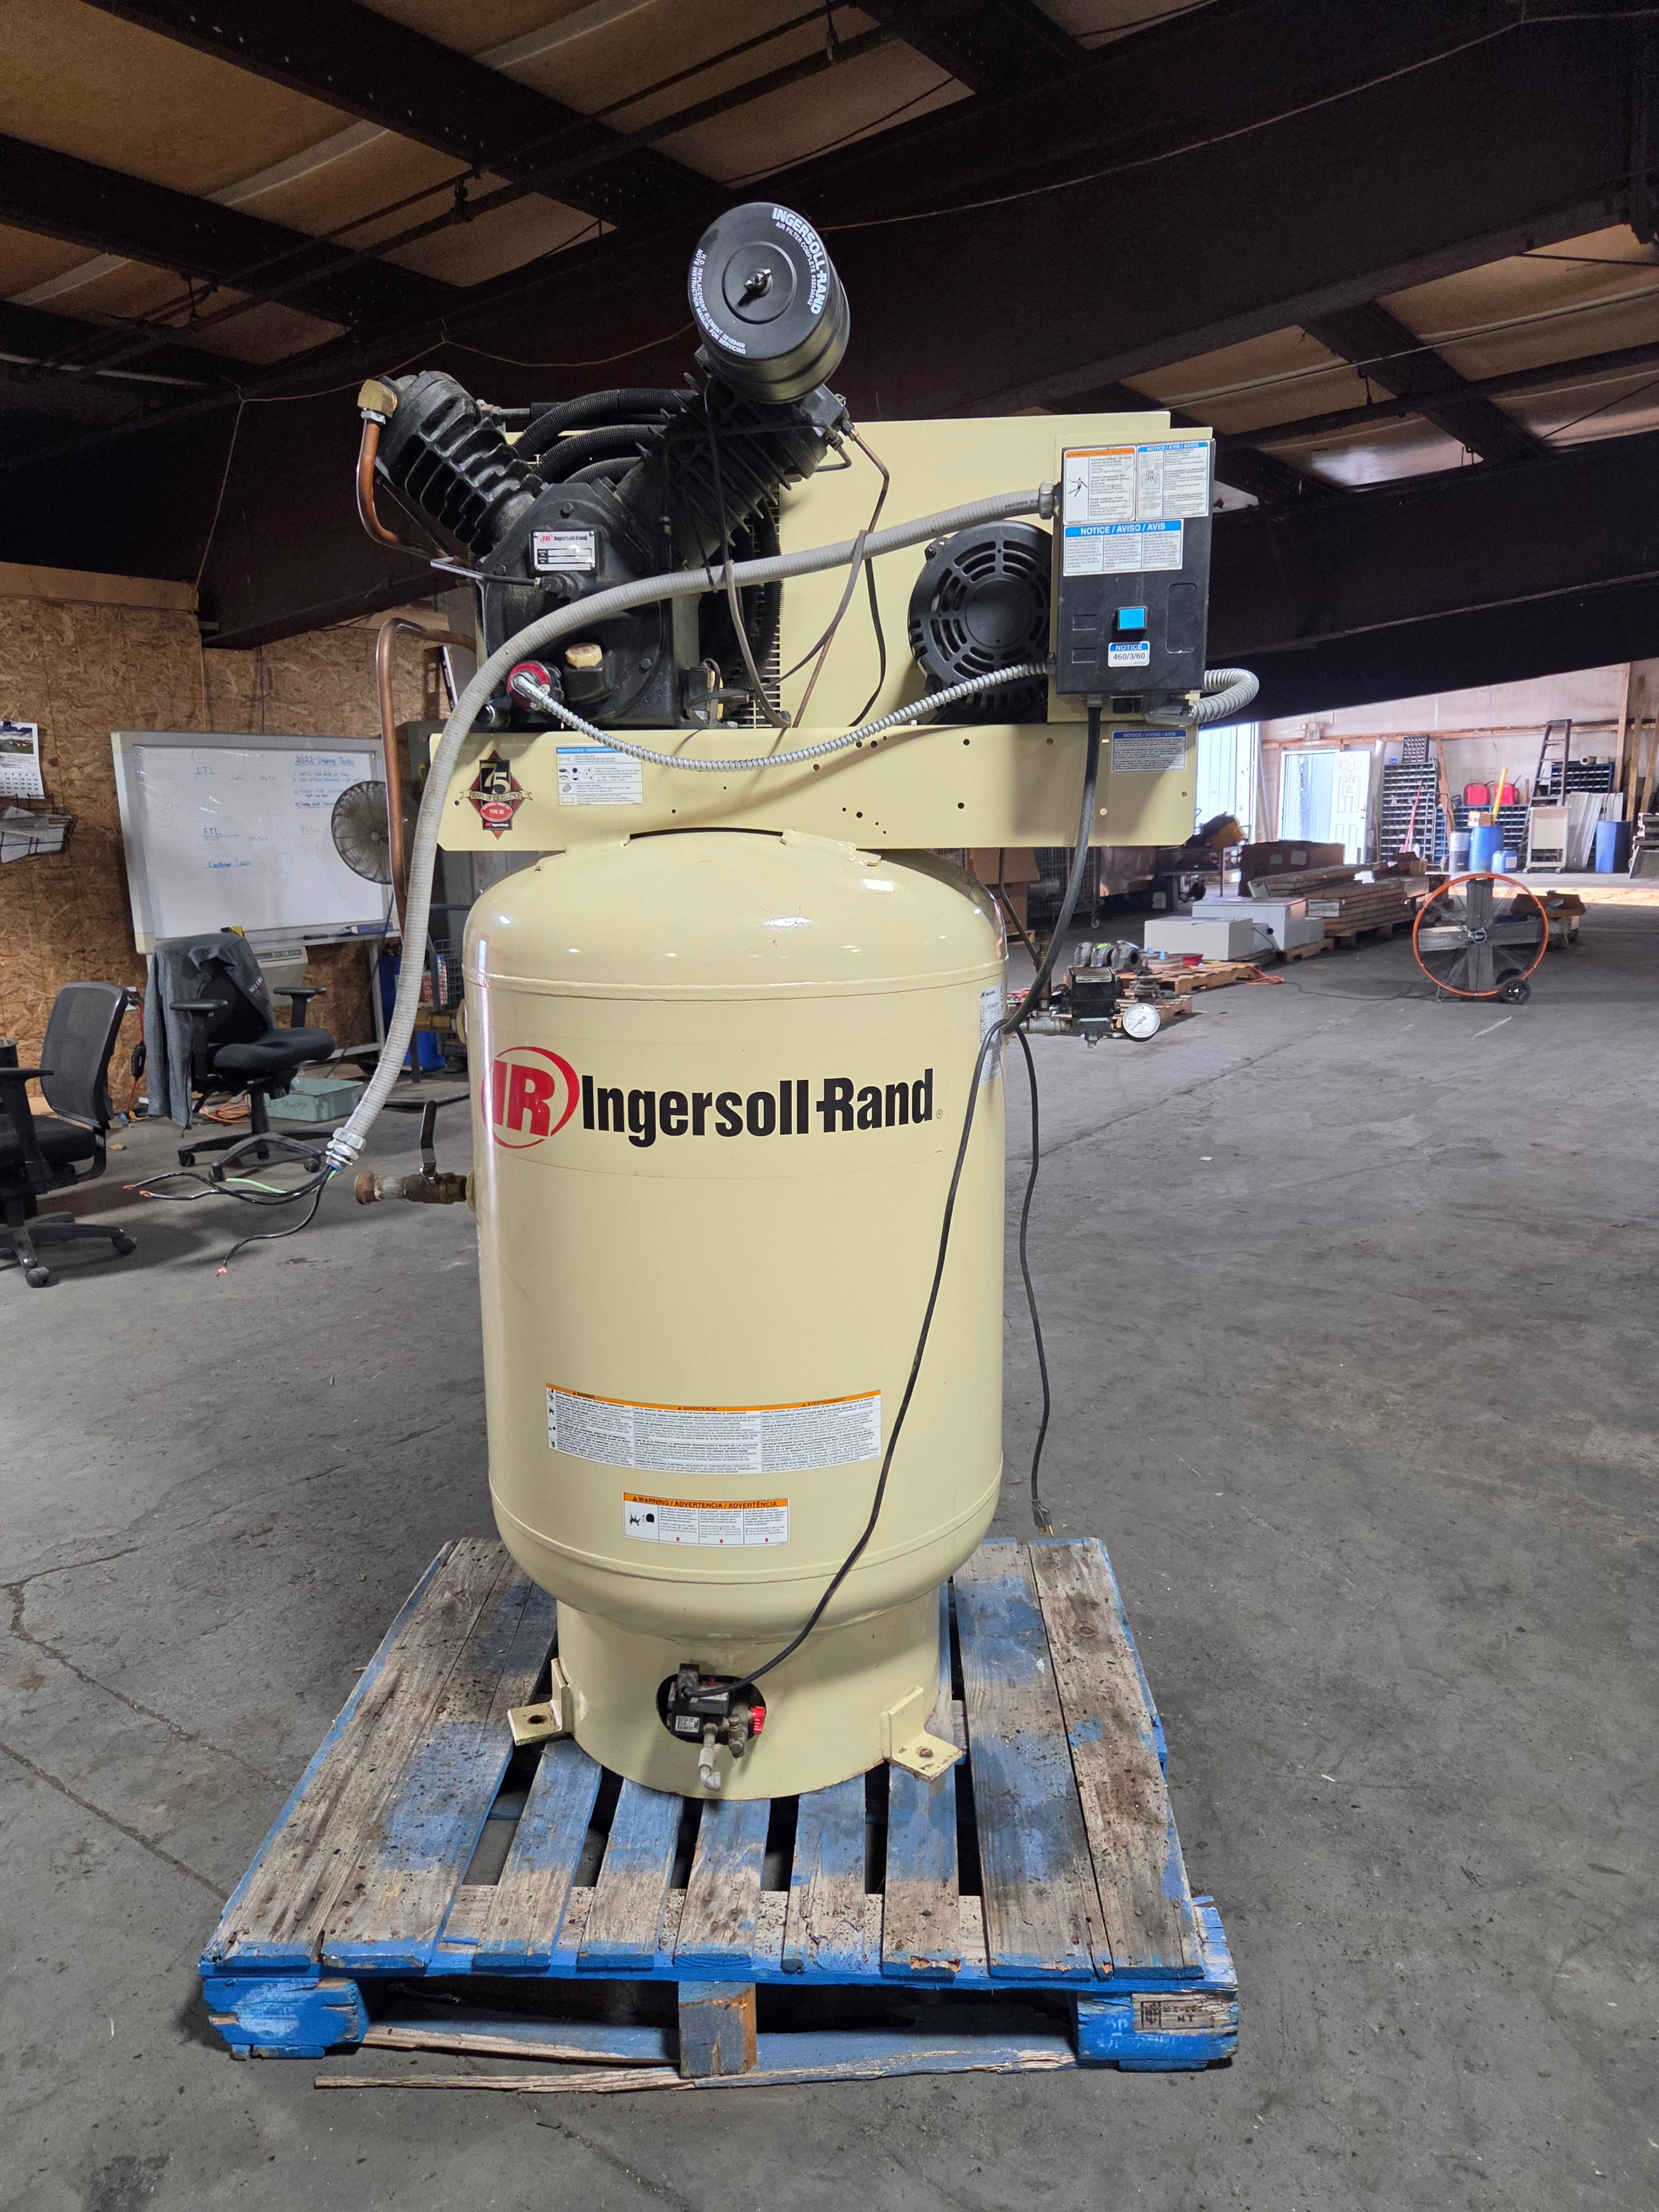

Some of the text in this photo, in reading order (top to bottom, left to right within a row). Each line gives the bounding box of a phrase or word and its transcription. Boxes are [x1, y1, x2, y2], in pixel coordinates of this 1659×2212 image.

[775, 221, 785, 230] AIR
[786, 227, 802, 243] FILTER
[800, 242, 816, 273] COMPLETE
[691, 248, 746, 354] NOTE INSTRUCTION MANUAL FOR SERVICING
[697, 268, 707, 311] REPLACEMENT
[704, 312, 723, 335] ELEMENT
[1081, 526, 1110, 535] NOTICE
[1117, 524, 1141, 533] AVISO
[1147, 523, 1166, 531] AVIS
[1113, 652, 1145, 661] 460/3/60
[1115, 643, 1142, 651] NOTICE
[481, 763, 511, 795] 75
[493, 1061, 555, 1138] IR
[638, 1496, 669, 1506] WARNING
[675, 1499, 722, 1509] ADVERTENCIA
[728, 1500, 778, 1509] ADVERTÊNCIA
